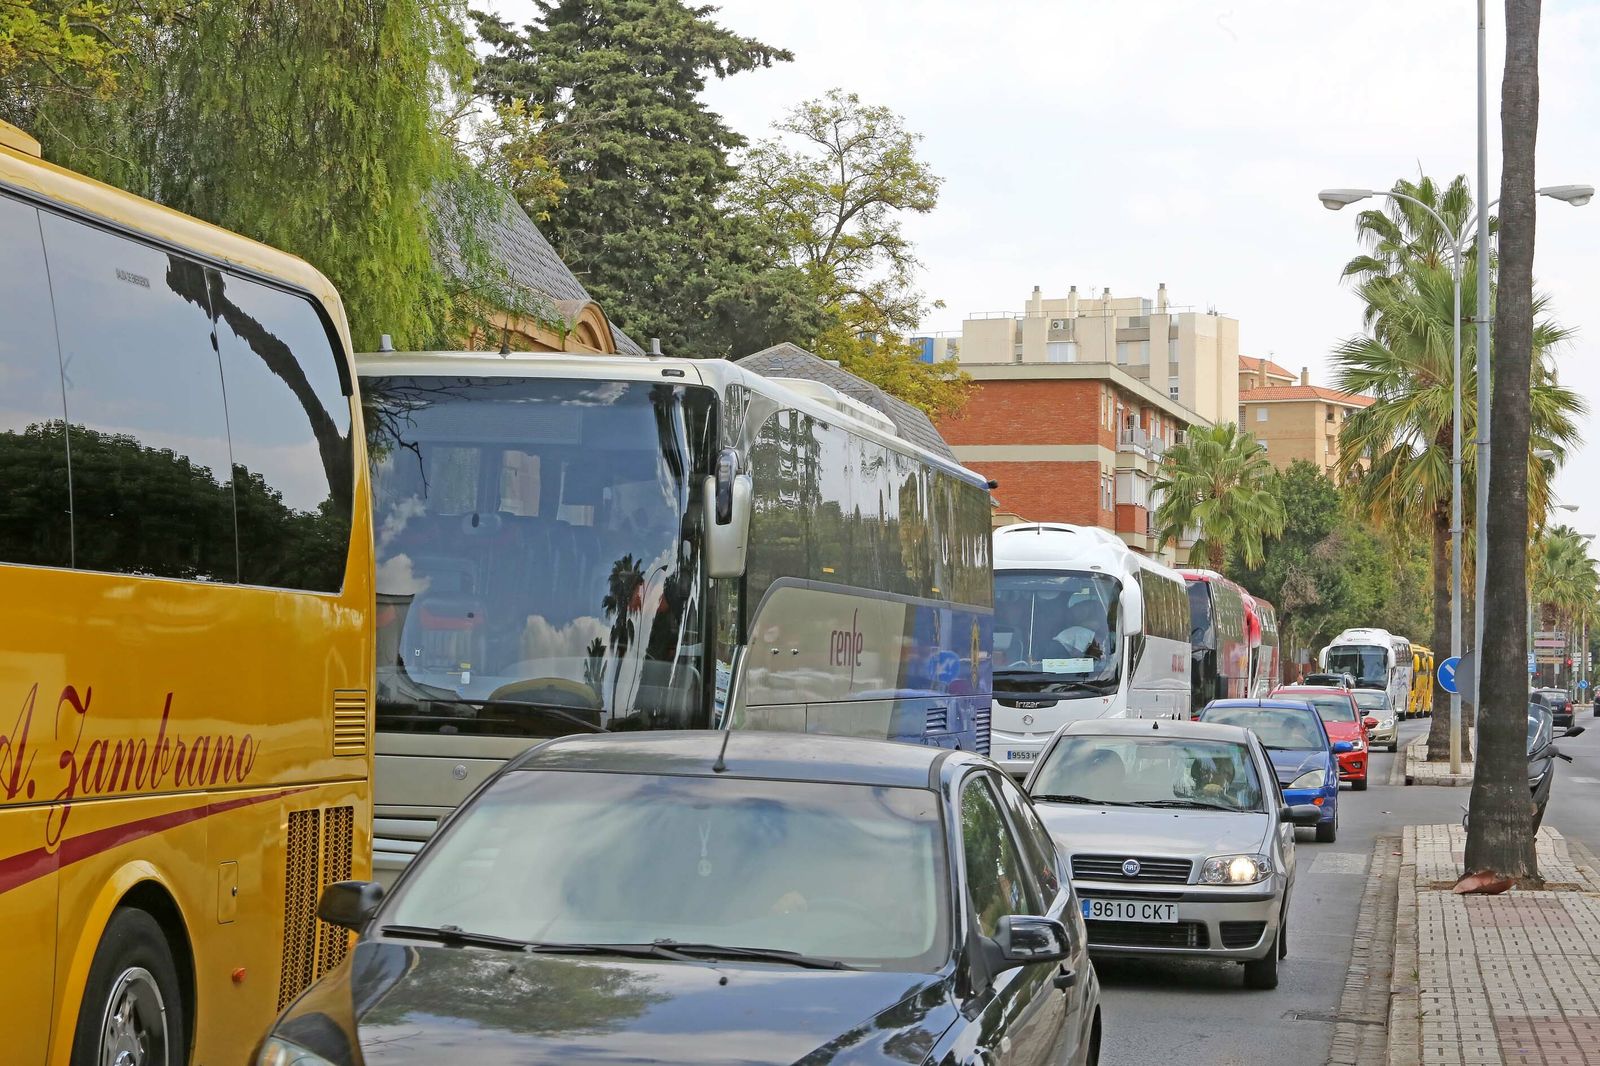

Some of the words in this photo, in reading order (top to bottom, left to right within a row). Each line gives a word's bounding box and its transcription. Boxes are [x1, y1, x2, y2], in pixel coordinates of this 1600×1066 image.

[830, 607, 863, 690] renfe
[45, 685, 261, 846] Zambrano
[1012, 751, 1030, 759] 9553
[1093, 901, 1136, 919] 9610
[1142, 904, 1174, 920] CKT
